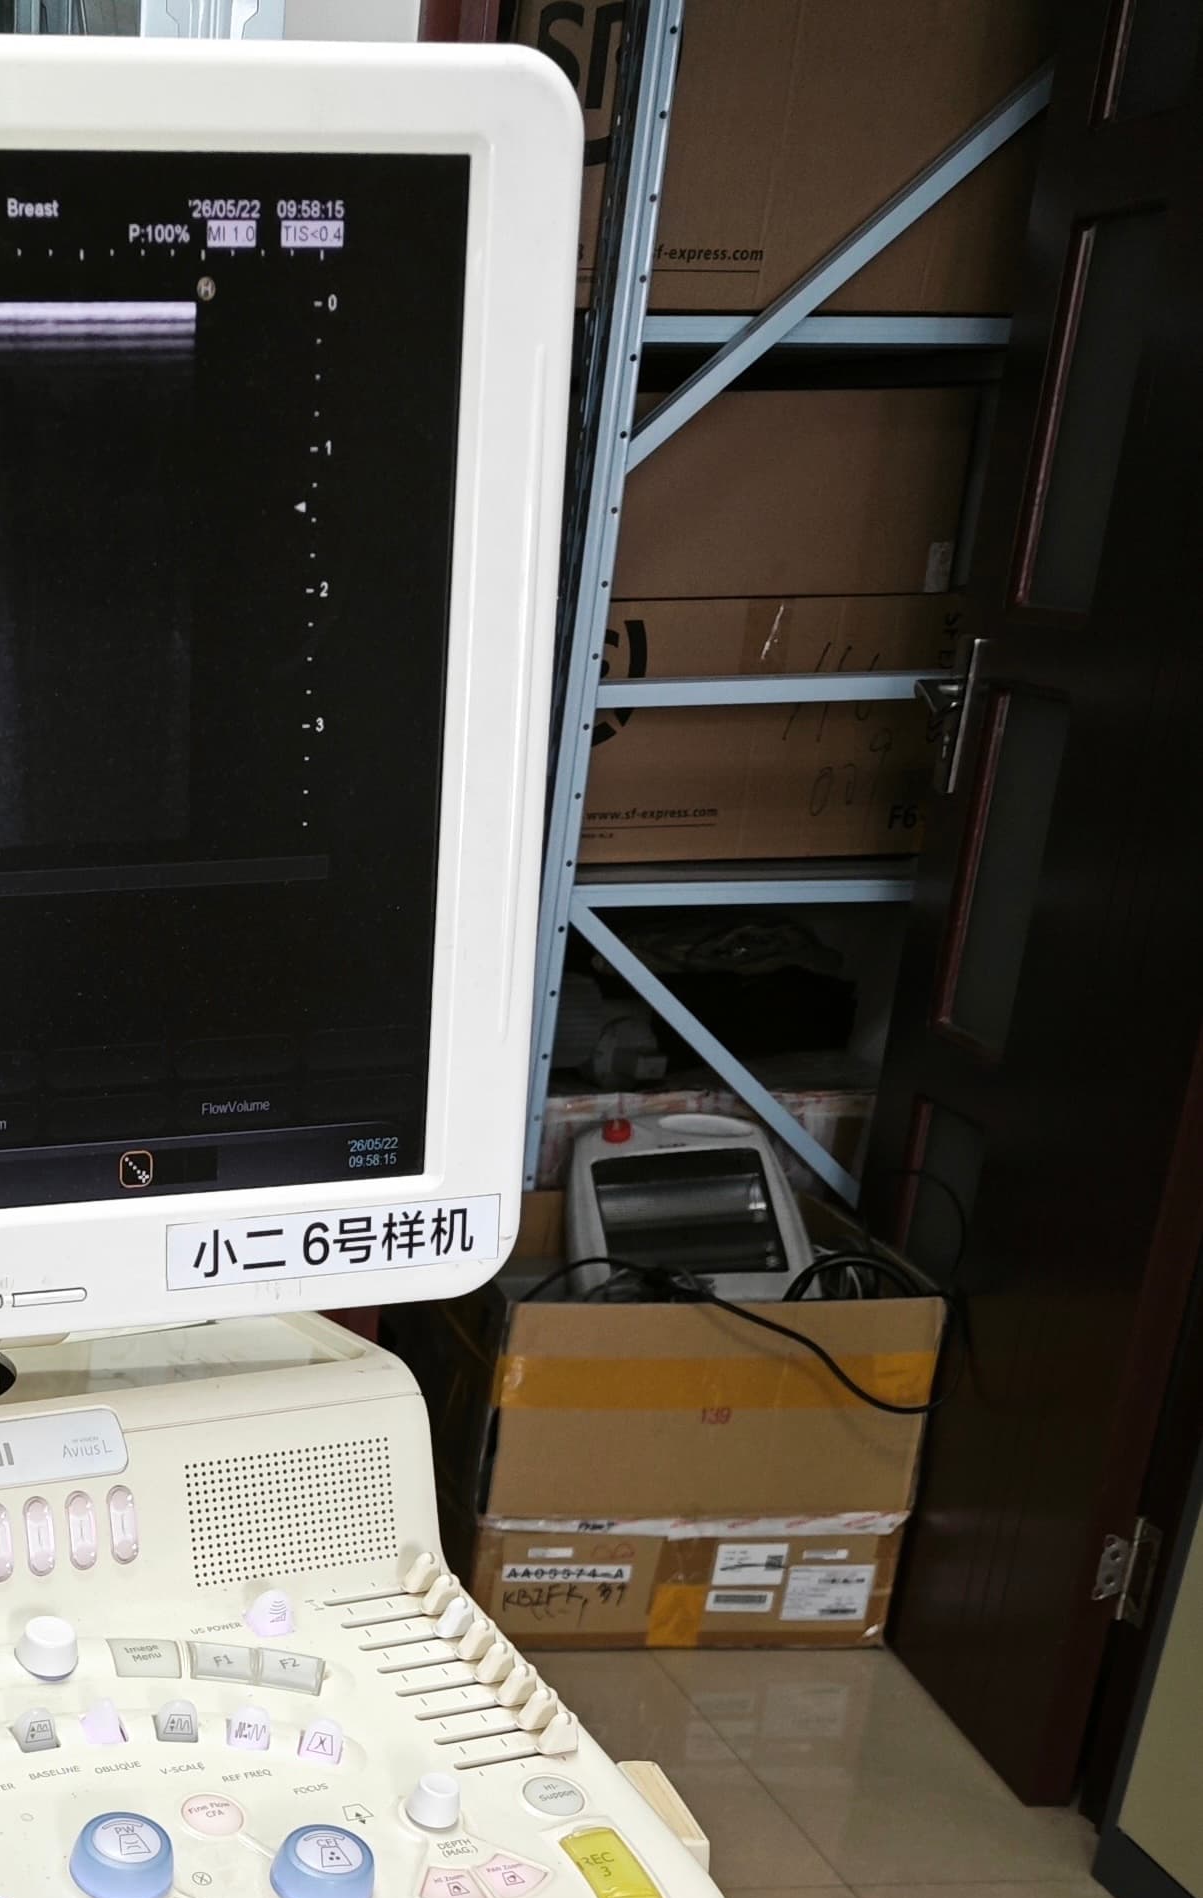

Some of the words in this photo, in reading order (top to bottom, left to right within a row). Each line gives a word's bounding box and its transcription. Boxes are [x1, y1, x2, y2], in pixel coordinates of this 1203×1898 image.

[6, 198, 59, 218] Breast
[188, 199, 261, 220] '26/05/22
[276, 199, 345, 220] 09:58:15
[128, 223, 191, 244] P:100%
[207, 225, 228, 243] MI
[231, 225, 256, 243] 1.0
[282, 225, 343, 243] TIS<0.4
[328, 295, 337, 311] 0
[319, 581, 329, 598] 2
[315, 717, 325, 733] 3
[587, 806, 719, 823] www.sf-express.com
[201, 1098, 271, 1116] FlowVolume
[348, 1152, 398, 1169] 09:58:15
[192, 1226, 287, 1279] 小二
[301, 1206, 474, 1267] 6号样机
[206, 1620, 244, 1634] POWER
[213, 1654, 234, 1668] F1
[278, 1657, 301, 1670] F2
[27, 1764, 83, 1782] BASELINE
[94, 1759, 143, 1775] OBLIQUE
[158, 1761, 206, 1777] V-SCALE
[221, 1773, 241, 1783] REF
[244, 1768, 273, 1780] FREQ
[292, 1782, 329, 1795] FOCUS
[113, 1825, 136, 1834] PW
[436, 1839, 473, 1851] DEPTH
[600, 1865, 613, 1878] 3
